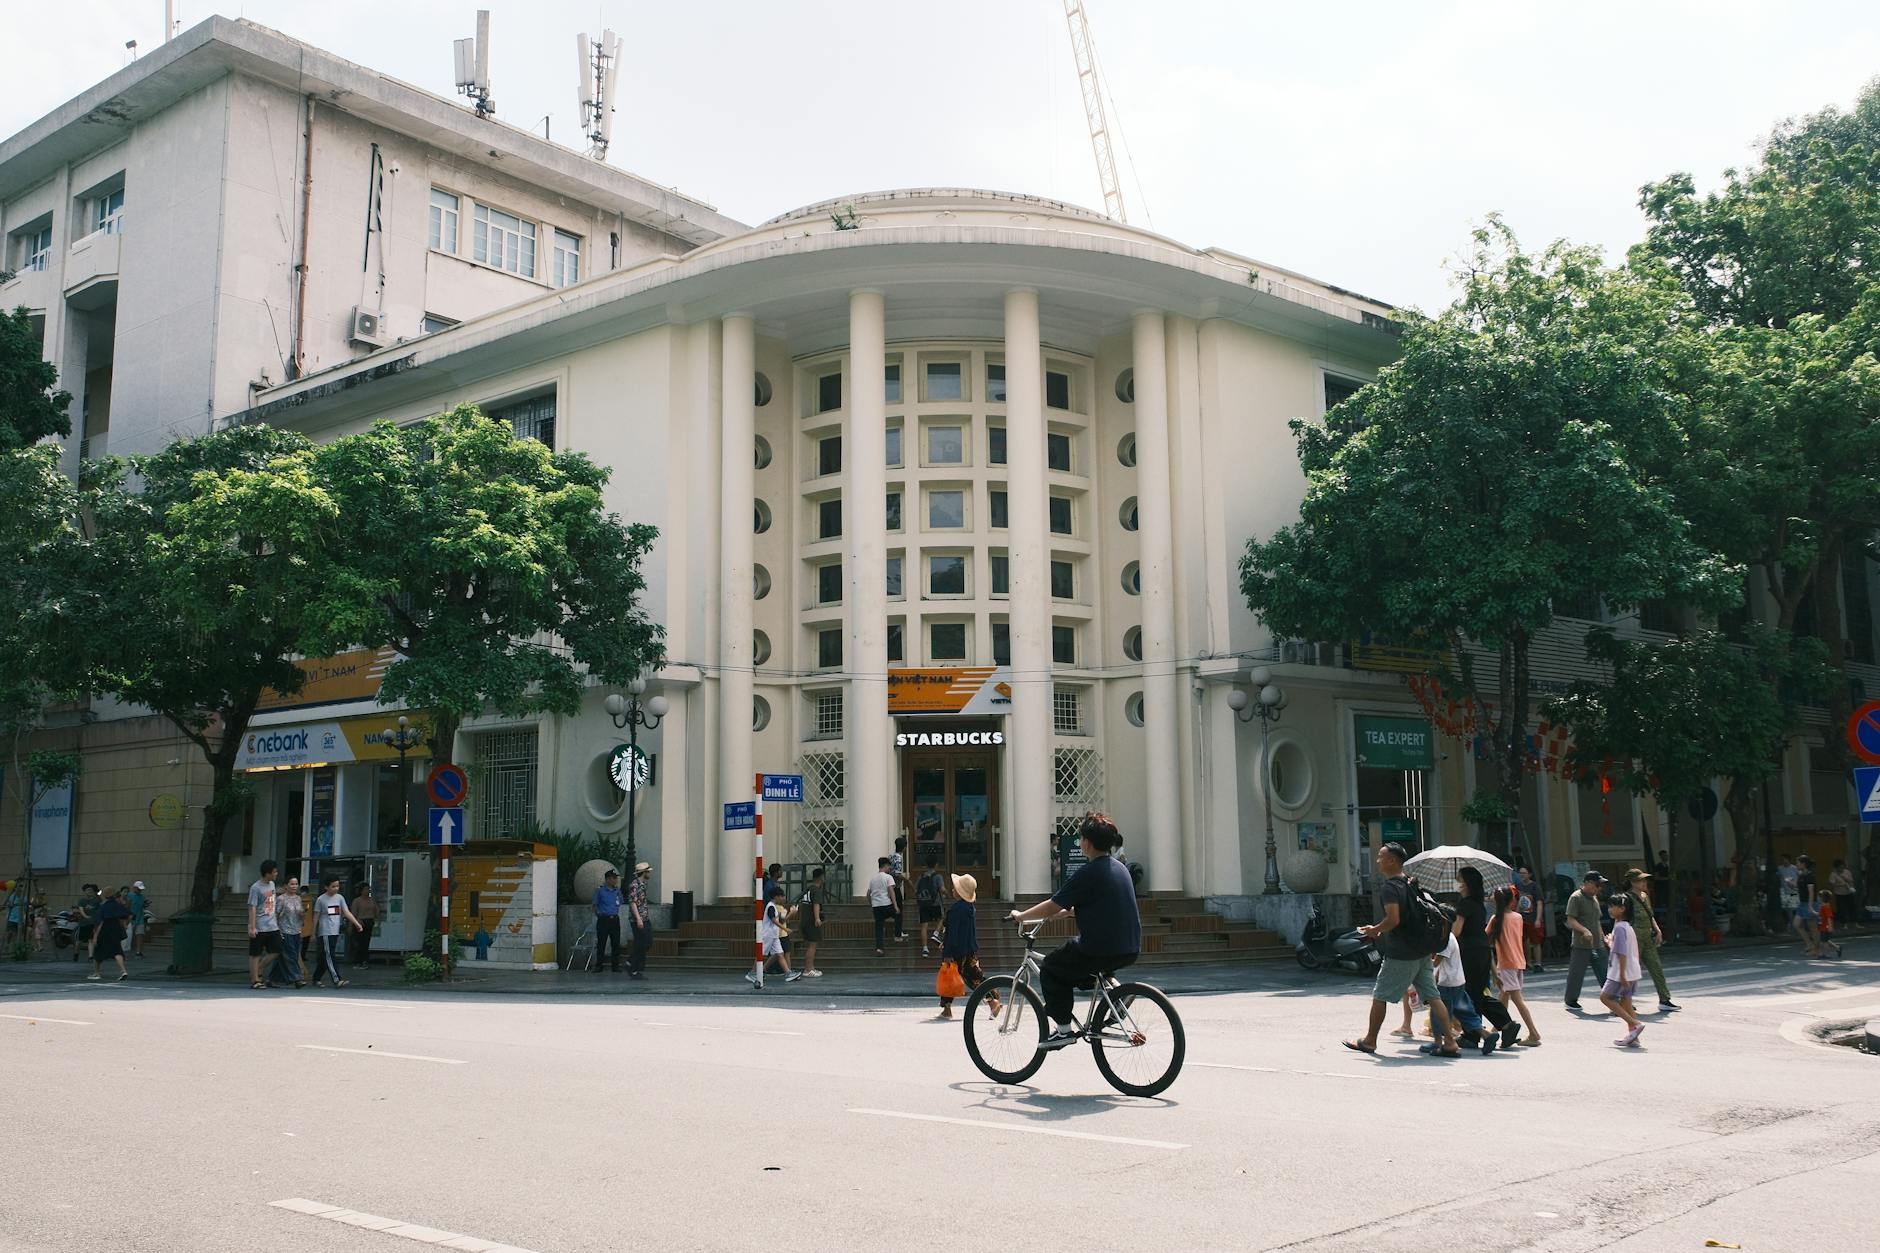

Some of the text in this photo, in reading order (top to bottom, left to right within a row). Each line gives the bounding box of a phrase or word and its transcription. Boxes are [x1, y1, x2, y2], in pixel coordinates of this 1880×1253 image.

[332, 664, 355, 676] NAM
[929, 675, 953, 683] NAM
[896, 732, 1003, 746] STARBUCKS
[1365, 731, 1425, 746] TEA EXPERT
[765, 788, 787, 798] ĐINH
